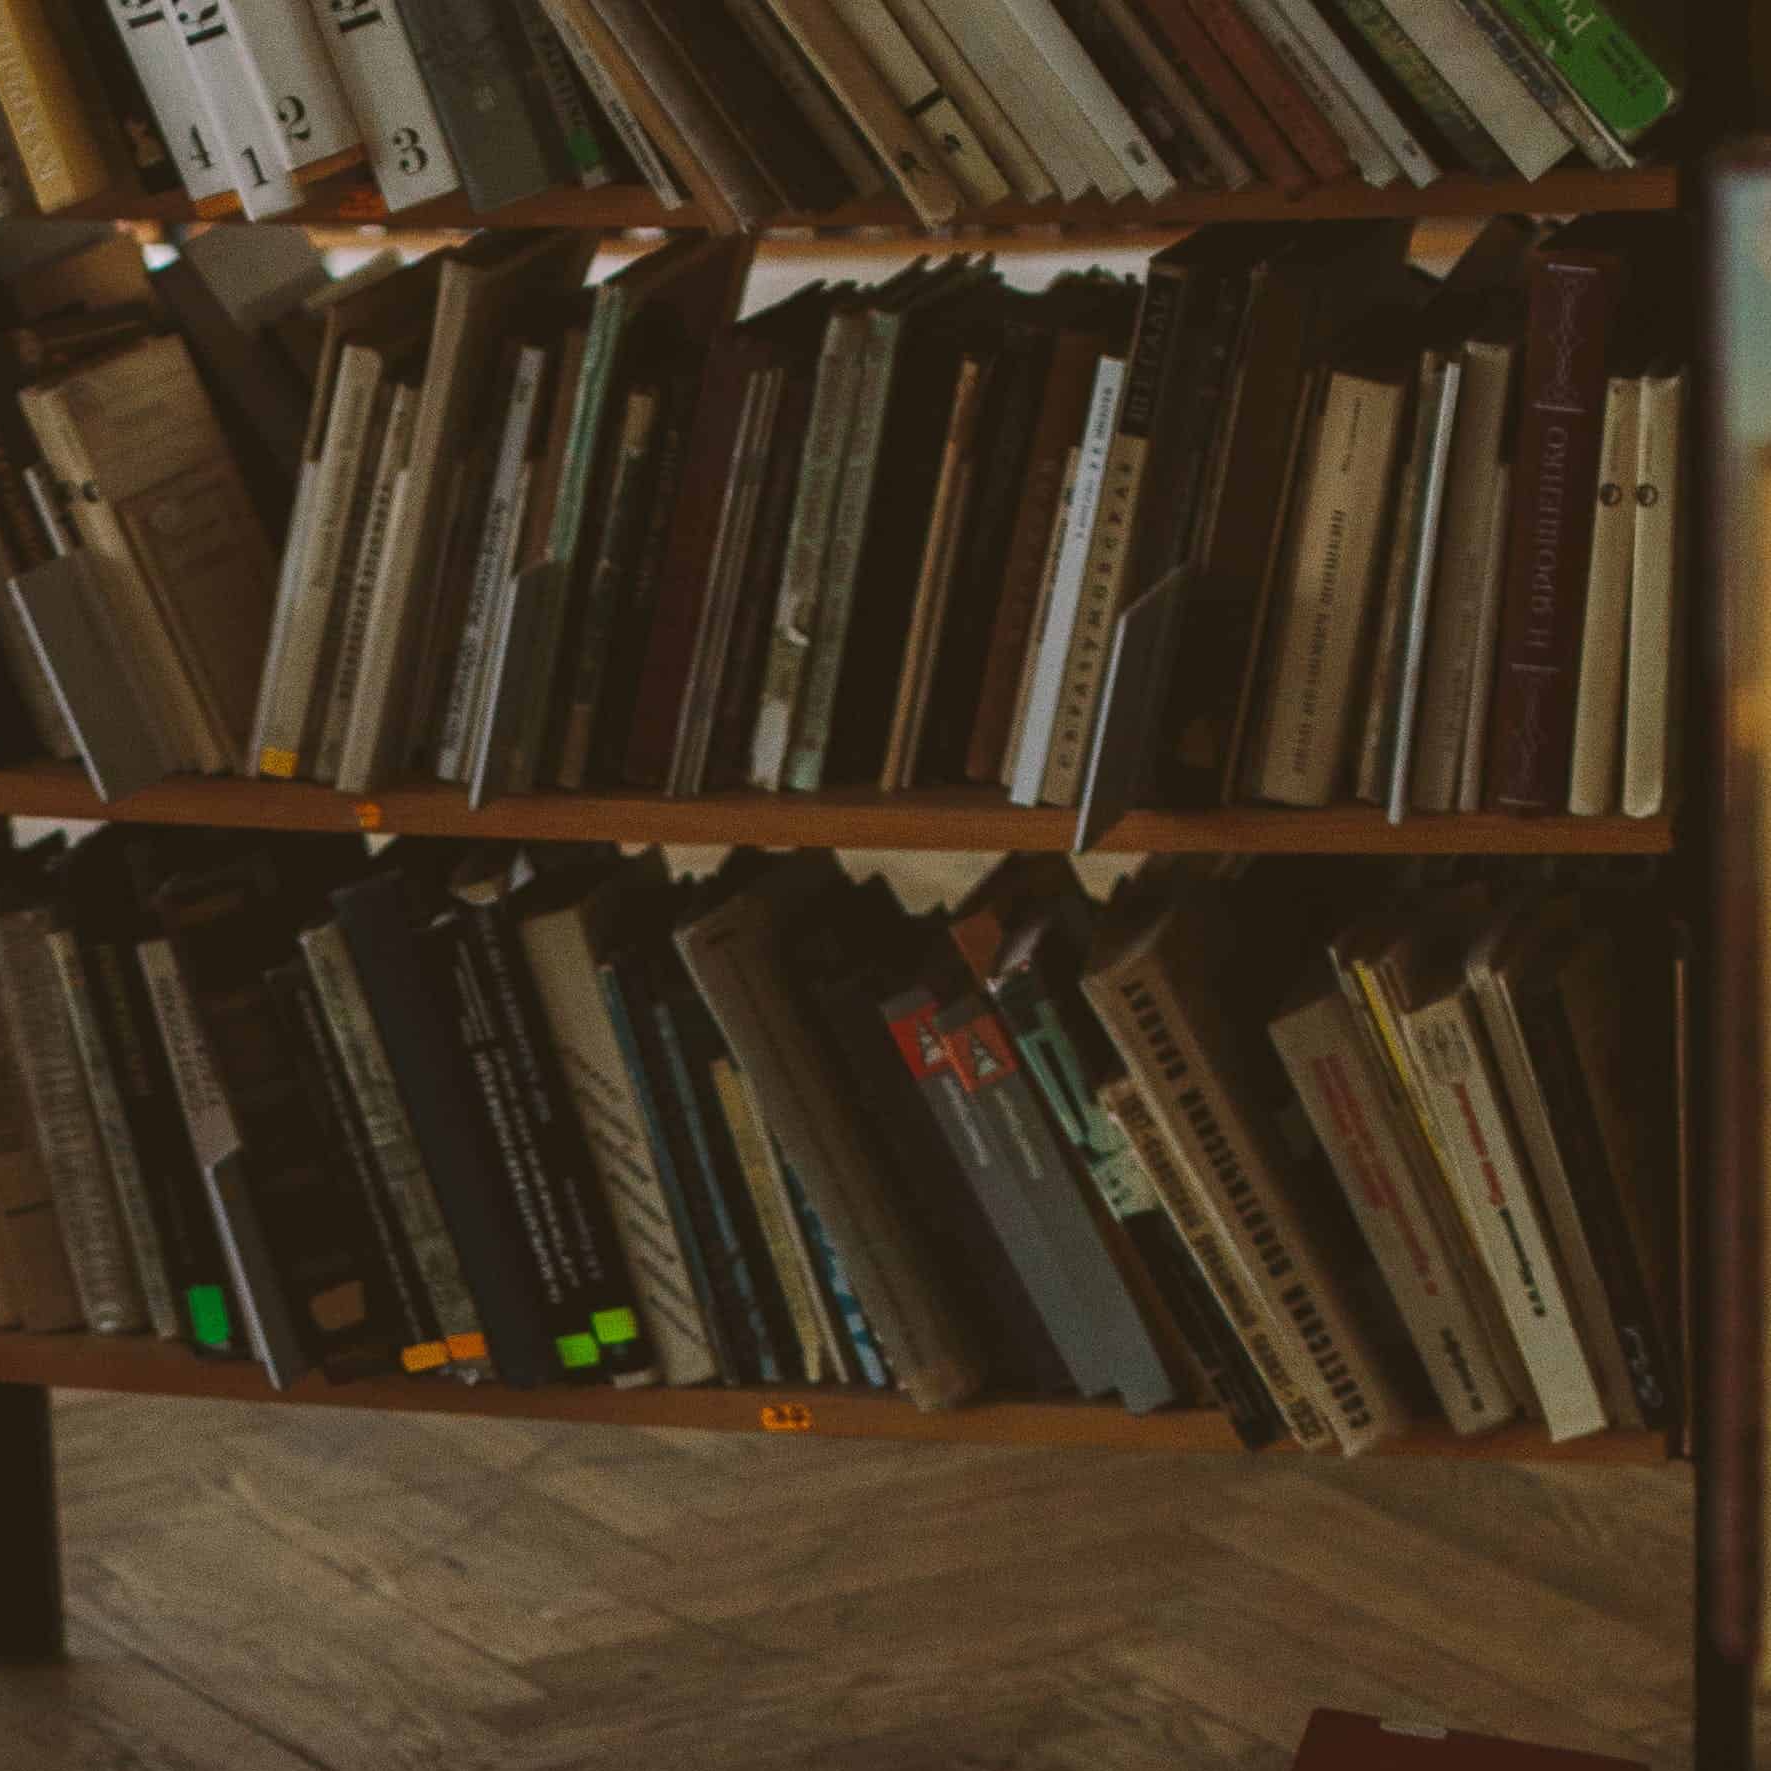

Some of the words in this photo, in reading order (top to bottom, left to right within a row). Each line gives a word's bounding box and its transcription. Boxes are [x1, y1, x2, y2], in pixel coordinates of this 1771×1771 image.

[275, 96, 313, 141] 2
[189, 125, 215, 170] 4
[241, 146, 269, 187] 1
[390, 127, 429, 175] 3
